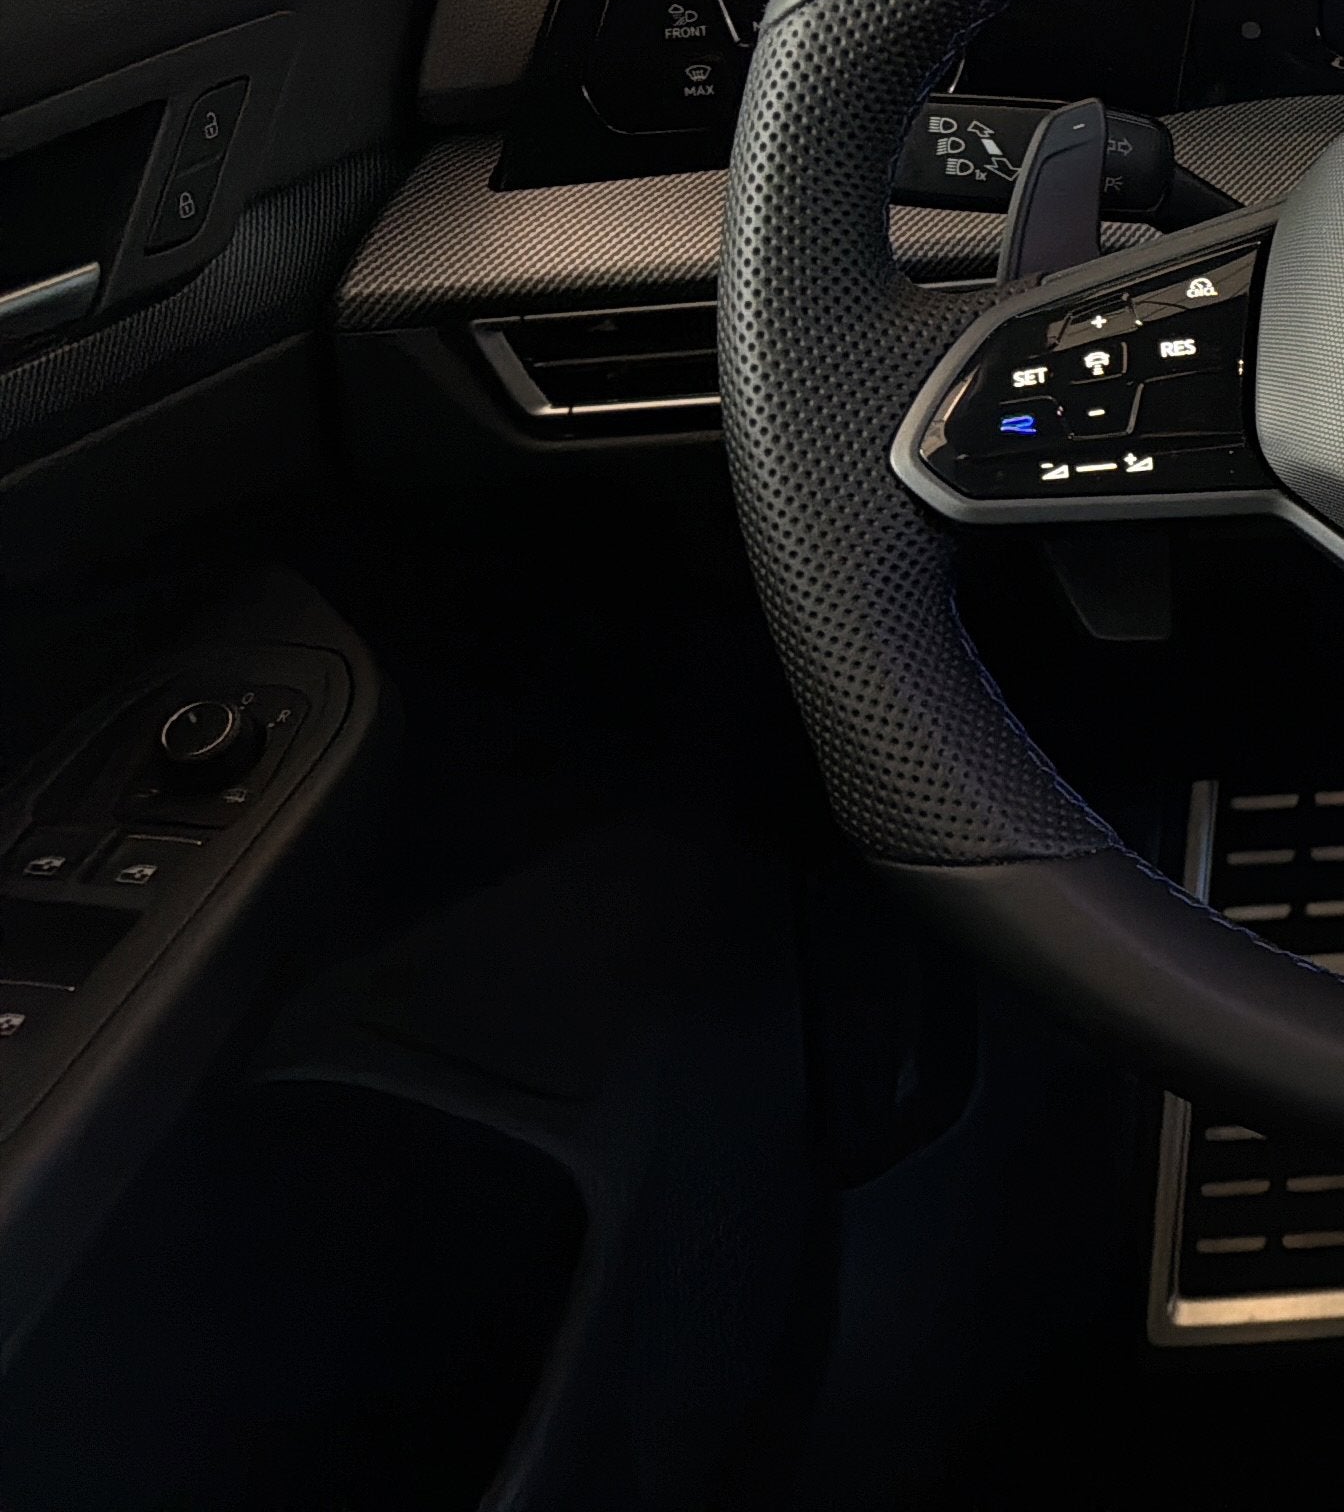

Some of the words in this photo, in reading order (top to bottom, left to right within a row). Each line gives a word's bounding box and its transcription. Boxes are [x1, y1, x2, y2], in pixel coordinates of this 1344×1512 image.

[664, 25, 707, 39] FRONT
[684, 85, 715, 97] MAX
[1160, 339, 1197, 358] RES
[1013, 367, 1048, 388] SET
